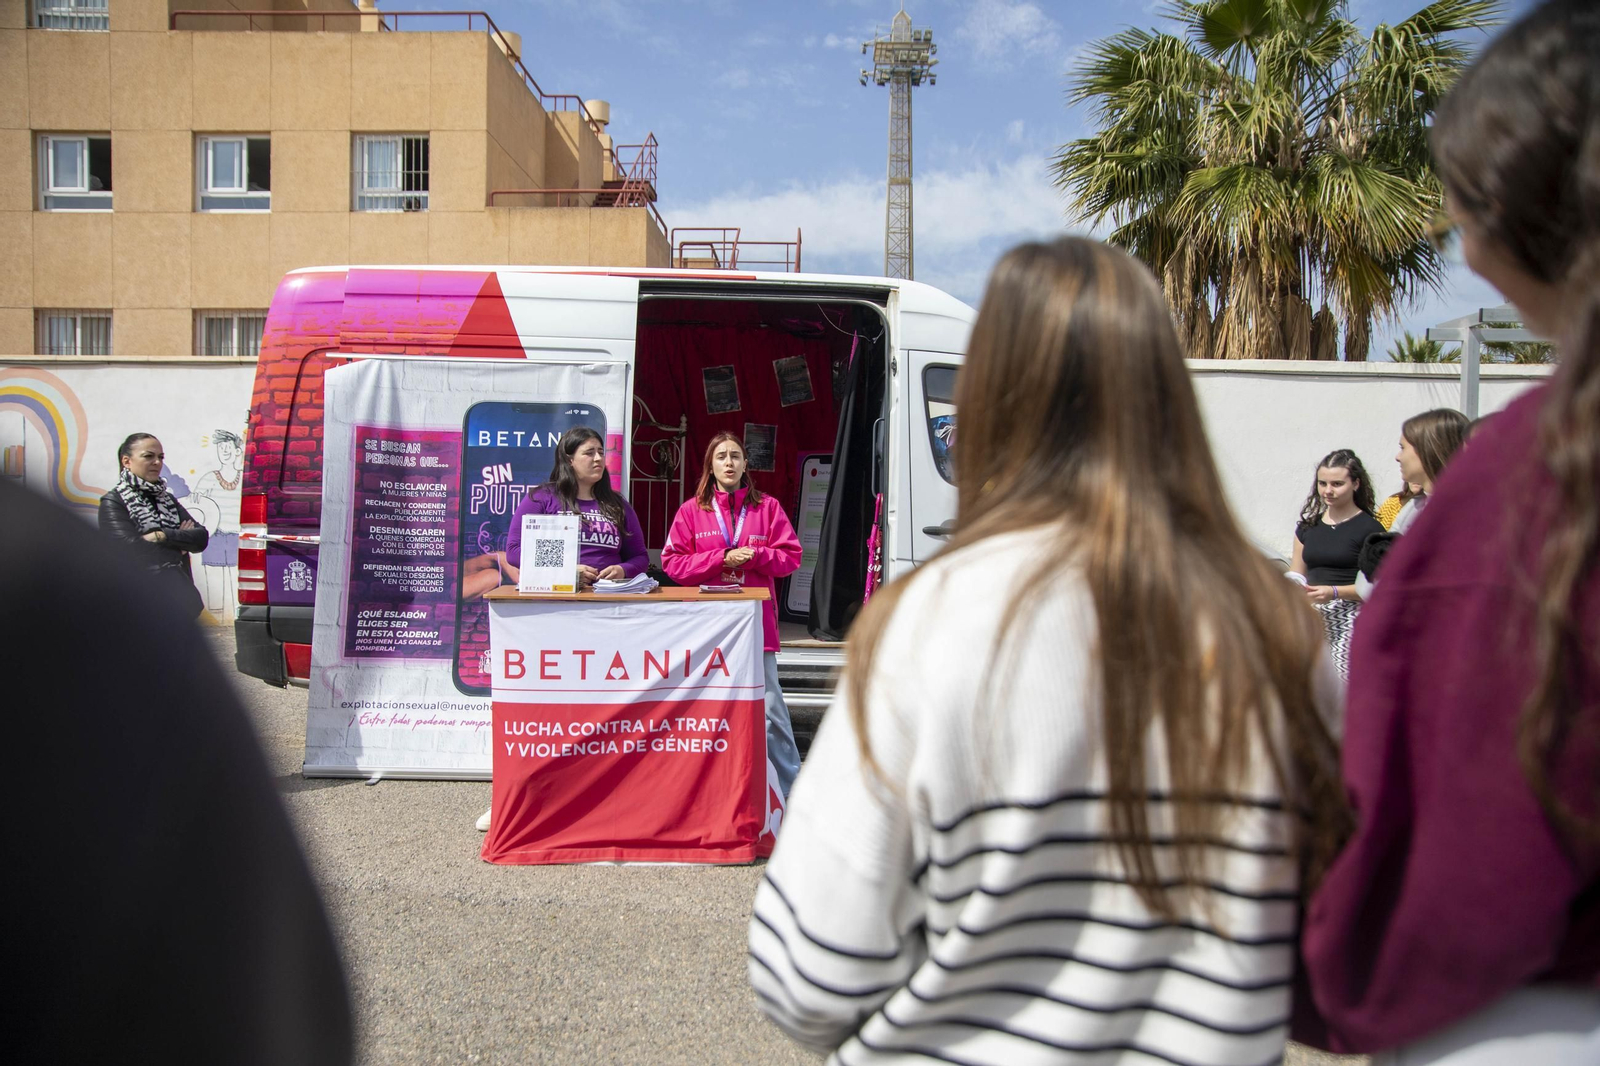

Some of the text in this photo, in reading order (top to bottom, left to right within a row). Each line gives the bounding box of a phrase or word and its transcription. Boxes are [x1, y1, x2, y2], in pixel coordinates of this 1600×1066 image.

[365, 439, 421, 454] SE BUSCAN
[479, 430, 562, 447] BETAN
[366, 452, 449, 468] PERSONAS QUE...
[482, 463, 513, 485] SIN
[395, 483, 447, 491] ESCLAVICEN
[470, 484, 540, 515] PUT
[375, 514, 419, 522] EXPLOTACIÓN
[370, 526, 445, 536] DESENMASCAREN
[582, 532, 620, 546] LAVAS
[358, 609, 426, 619] ¿QUÉ ESLABÓN
[504, 648, 730, 680] BETANIA
[389, 713, 411, 727] todos
[412, 714, 456, 731] podemos
[460, 720, 492, 732] rompe
[504, 718, 730, 737] LUCHA CONTRA LA TRATA
[505, 735, 728, 758] Y VIOLENCIA DE GÉNERO
